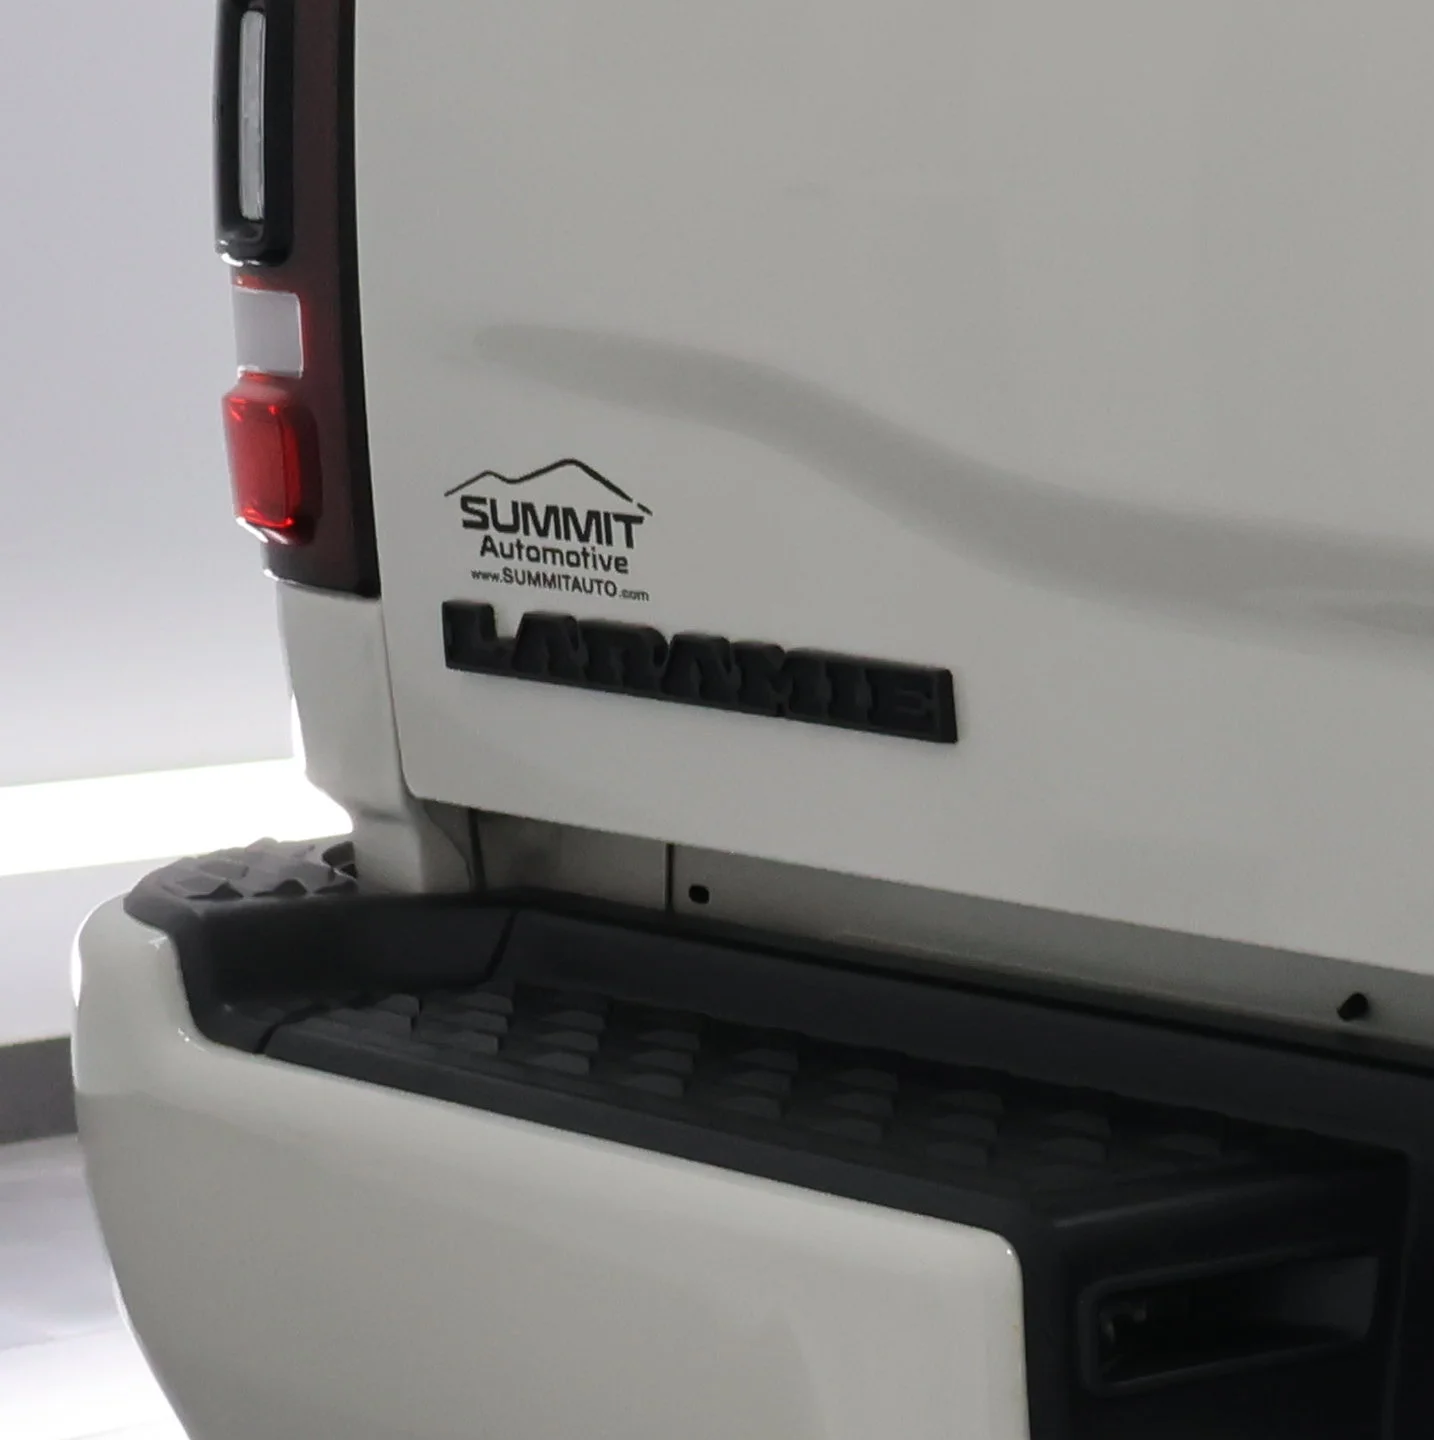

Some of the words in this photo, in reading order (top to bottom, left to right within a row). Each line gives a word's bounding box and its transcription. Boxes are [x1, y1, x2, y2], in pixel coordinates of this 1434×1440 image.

[461, 495, 644, 549] SUMMIT
[480, 535, 629, 574] Automotive
[471, 567, 650, 602] www.SUMMITAUTO.com
[442, 600, 959, 745] LARAMIE
